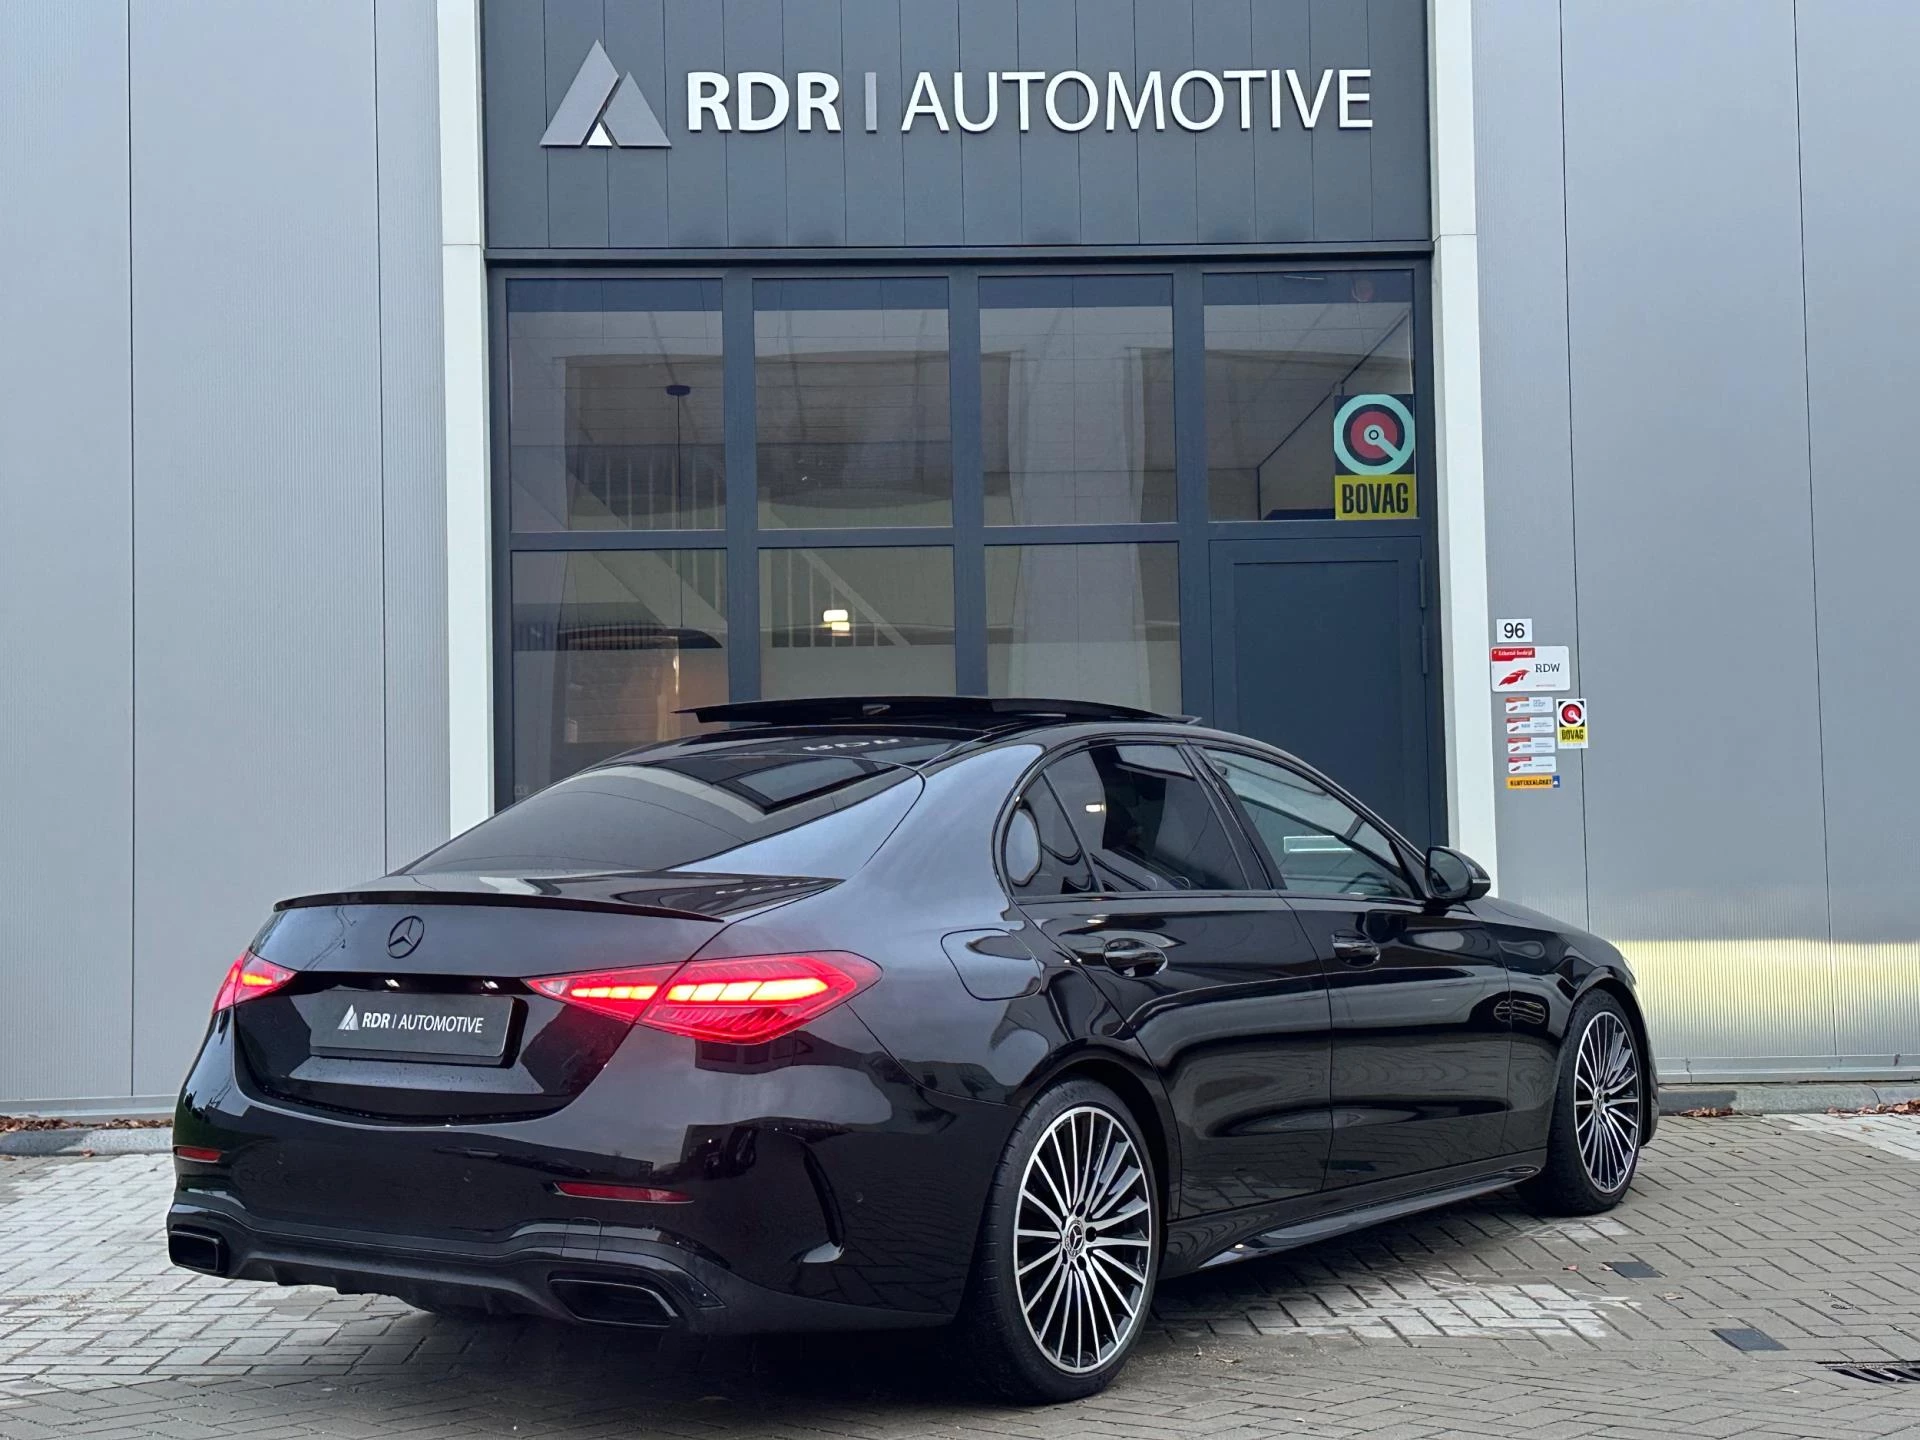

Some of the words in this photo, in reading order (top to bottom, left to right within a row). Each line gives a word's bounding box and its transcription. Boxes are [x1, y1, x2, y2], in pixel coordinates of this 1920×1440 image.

[687, 71, 842, 133] RDR
[901, 67, 1374, 133] AUTOMOTIVE
[1341, 482, 1409, 514] BOVAG
[1503, 622, 1526, 639] 96
[1535, 663, 1561, 673] RDW
[1561, 729, 1584, 741] BOVAG
[362, 1012, 391, 1029] RDR
[398, 1014, 484, 1034] AUTOMOTIVE
